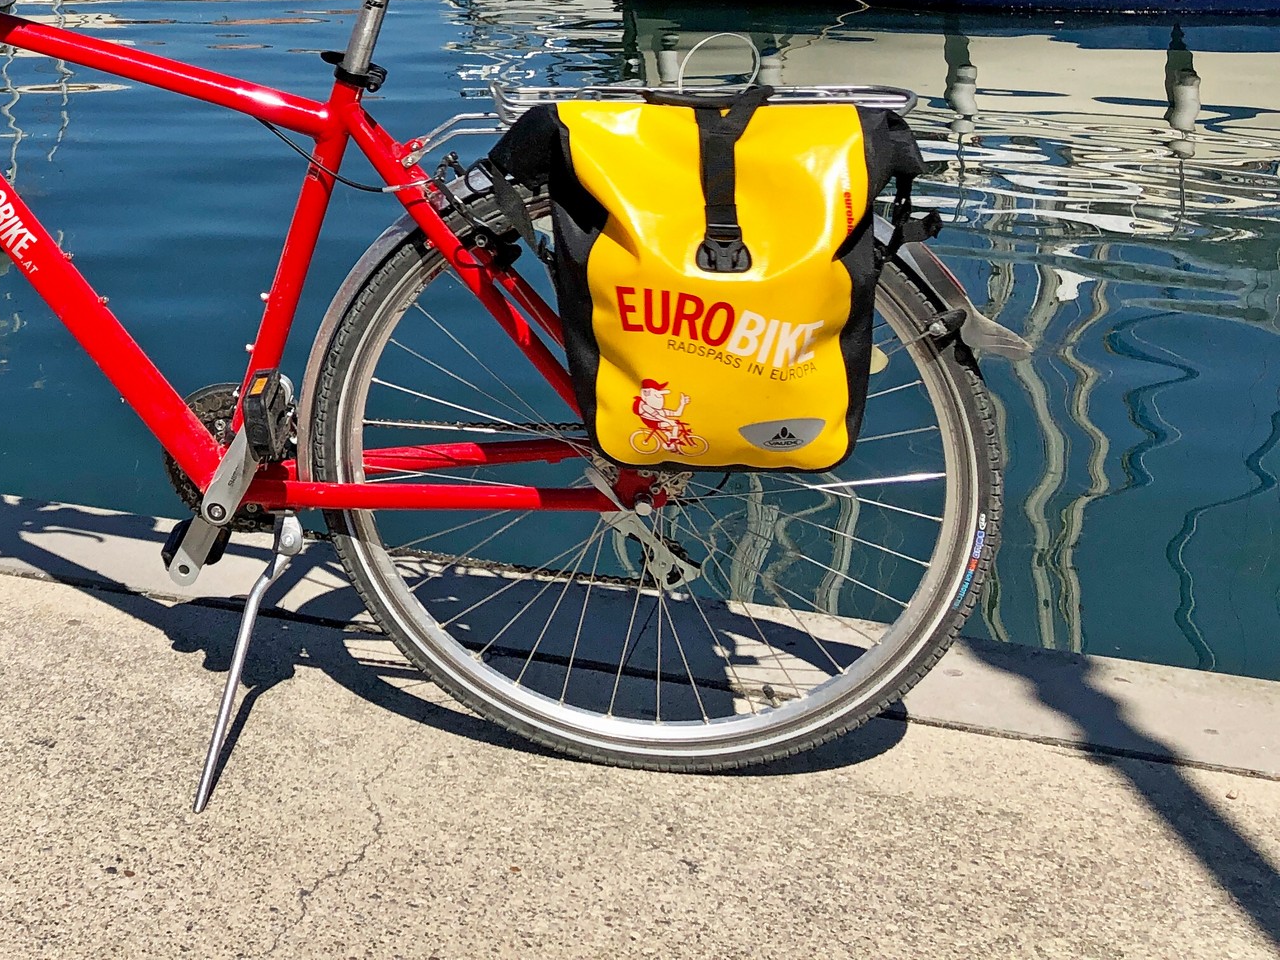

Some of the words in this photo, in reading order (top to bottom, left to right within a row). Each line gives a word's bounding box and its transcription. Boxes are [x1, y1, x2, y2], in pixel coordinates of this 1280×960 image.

[615, 286, 824, 369] EUROBIKE
[667, 339, 742, 369] RADSPASS
[747, 363, 765, 376] IN
[769, 362, 818, 382] EUROPA
